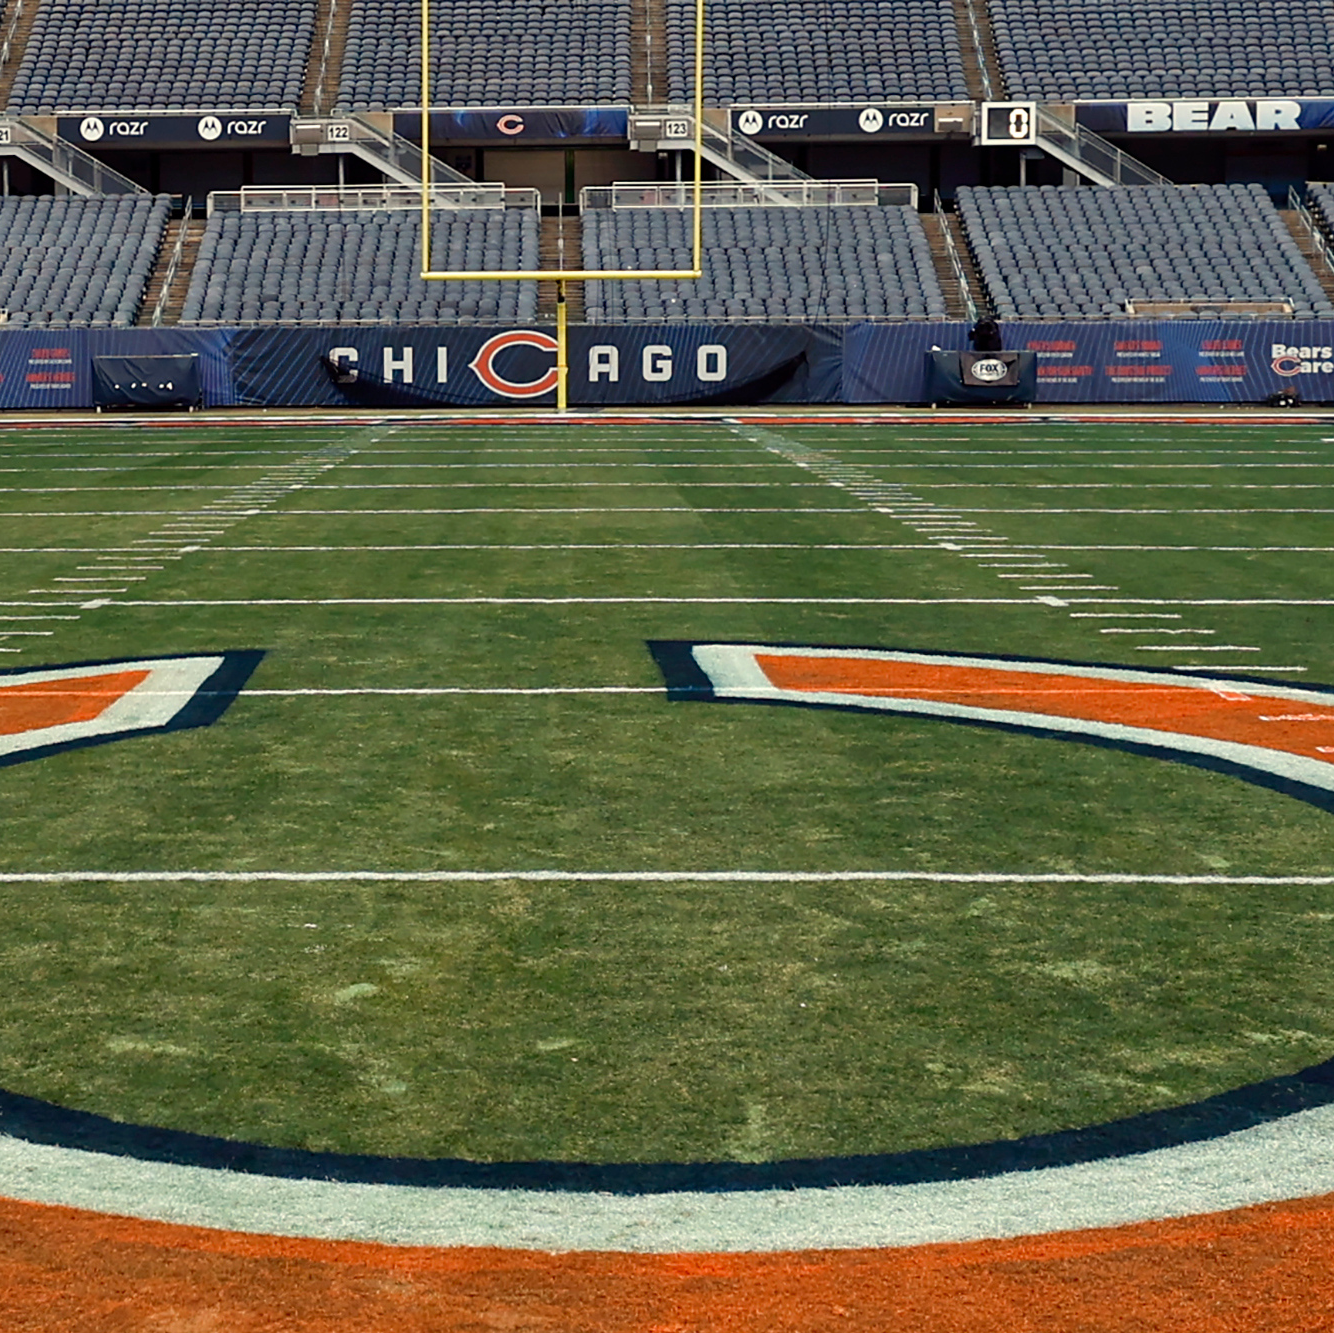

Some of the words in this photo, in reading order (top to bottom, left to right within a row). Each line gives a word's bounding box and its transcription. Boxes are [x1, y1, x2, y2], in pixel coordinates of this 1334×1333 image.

[768, 114, 808, 129] razr
[888, 113, 929, 127] razr
[1127, 101, 1301, 132] BEAR
[108, 121, 149, 136] razr
[227, 120, 267, 135] razr
[328, 126, 348, 138] 122
[667, 123, 687, 135] 123
[1271, 344, 1332, 359] Bears
[1270, 355, 1334, 377] Care
